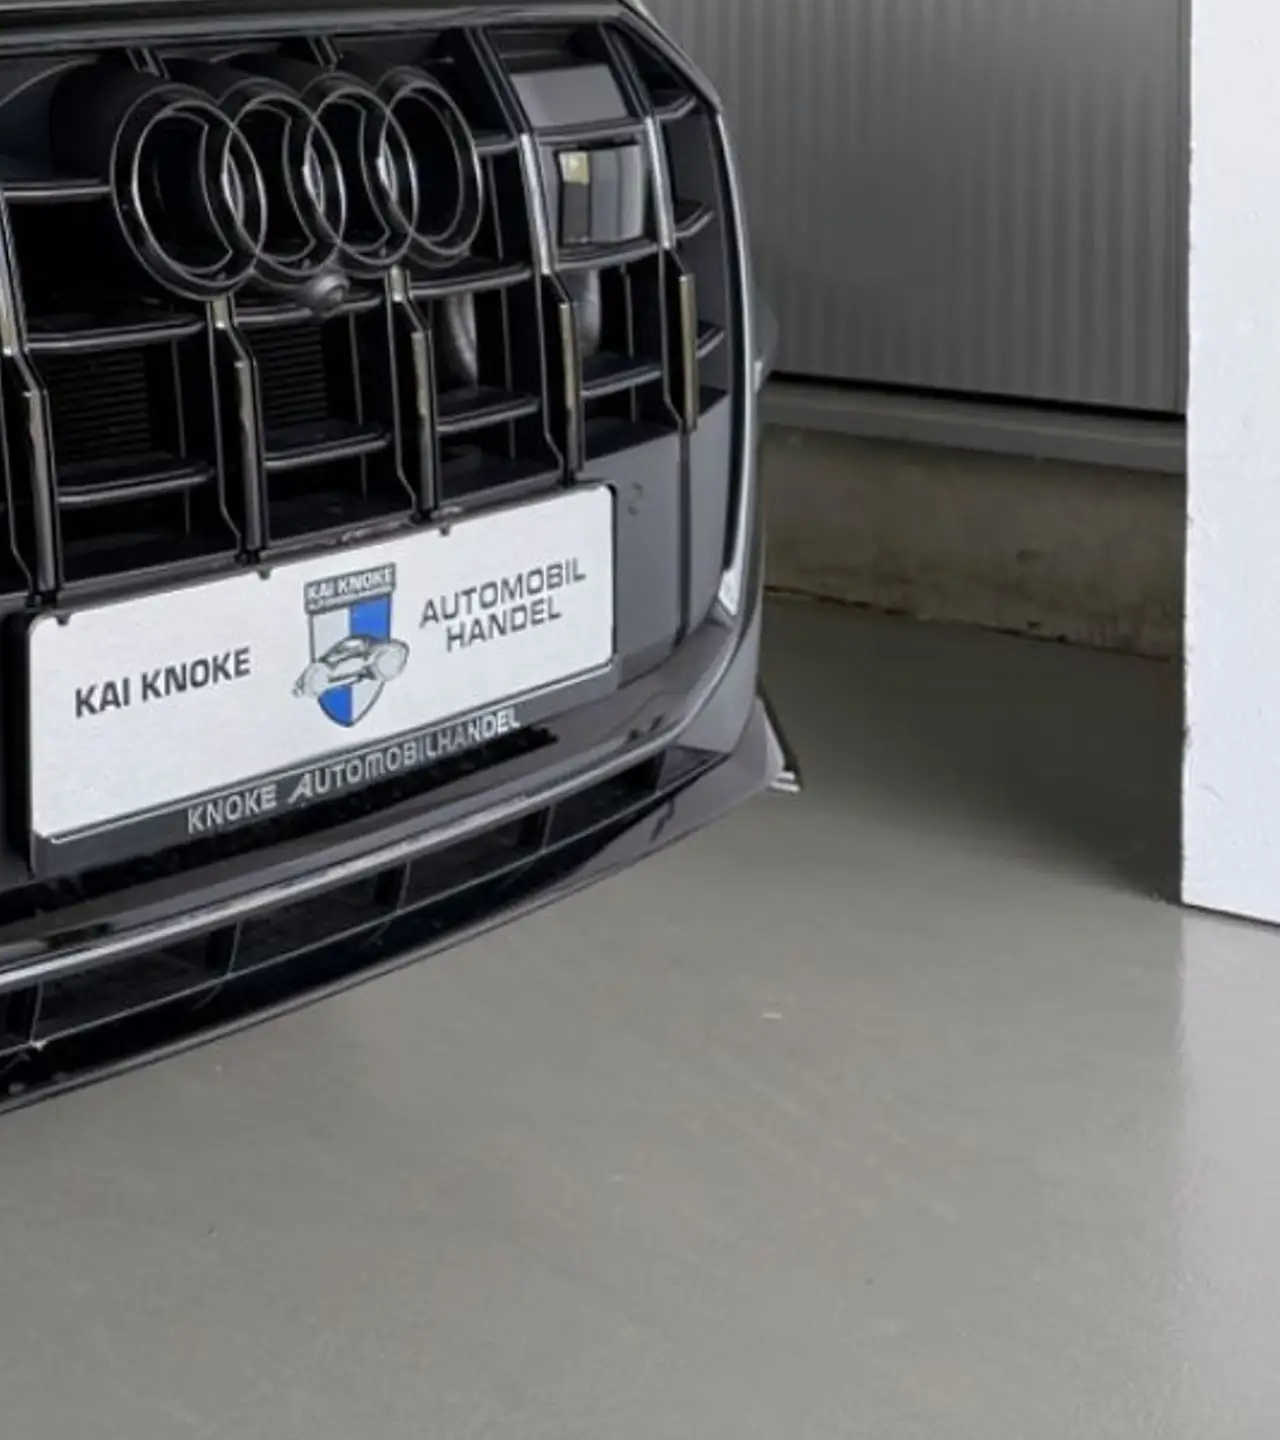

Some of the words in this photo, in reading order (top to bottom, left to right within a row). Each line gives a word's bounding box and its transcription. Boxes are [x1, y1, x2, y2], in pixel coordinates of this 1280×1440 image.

[418, 557, 586, 629] AUTOMOBIL
[445, 598, 562, 653] HANDEL
[74, 677, 131, 718] KAI
[142, 647, 251, 701] KNOKE
[187, 785, 277, 833] KNOKE
[288, 708, 520, 805] AUTOMOBILHANDEL
